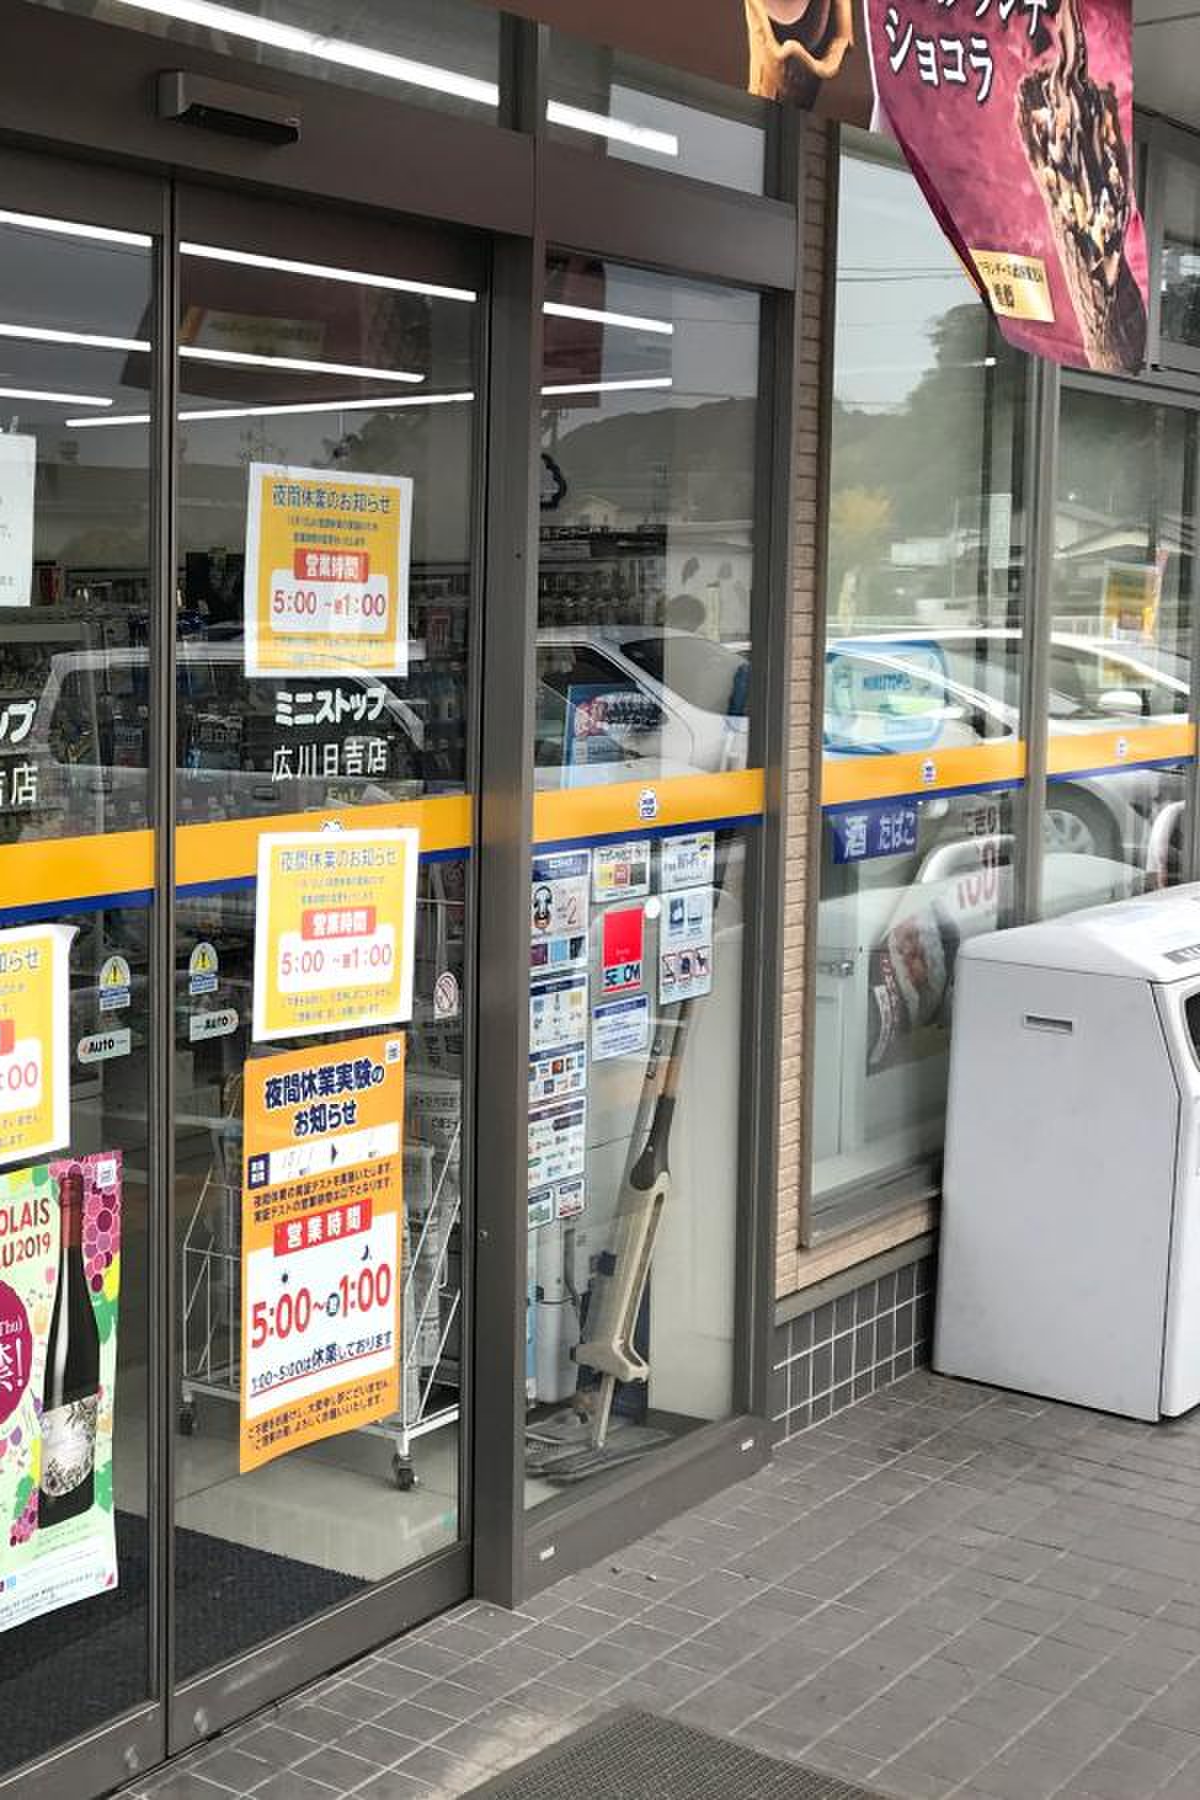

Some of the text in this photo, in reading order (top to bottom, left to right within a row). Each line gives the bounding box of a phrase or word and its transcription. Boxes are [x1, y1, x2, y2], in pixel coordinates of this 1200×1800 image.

[886, 8, 992, 102] ショコラ
[273, 484, 391, 514] 夜間休業のお知らせ
[305, 554, 360, 579] 営業時間
[275, 686, 387, 726] ミニストップ
[270, 738, 388, 783] 広川日吉店
[844, 815, 868, 858] 酒
[879, 810, 916, 849] たばこ
[280, 847, 397, 872] 夜間休業のお知らせ
[312, 911, 368, 936] 営業時間
[89, 1039, 114, 1054] AUTO
[265, 1058, 385, 1109] 夜間休業実験の
[294, 1100, 357, 1137] お知らせ
[287, 1205, 361, 1249] 営業時間
